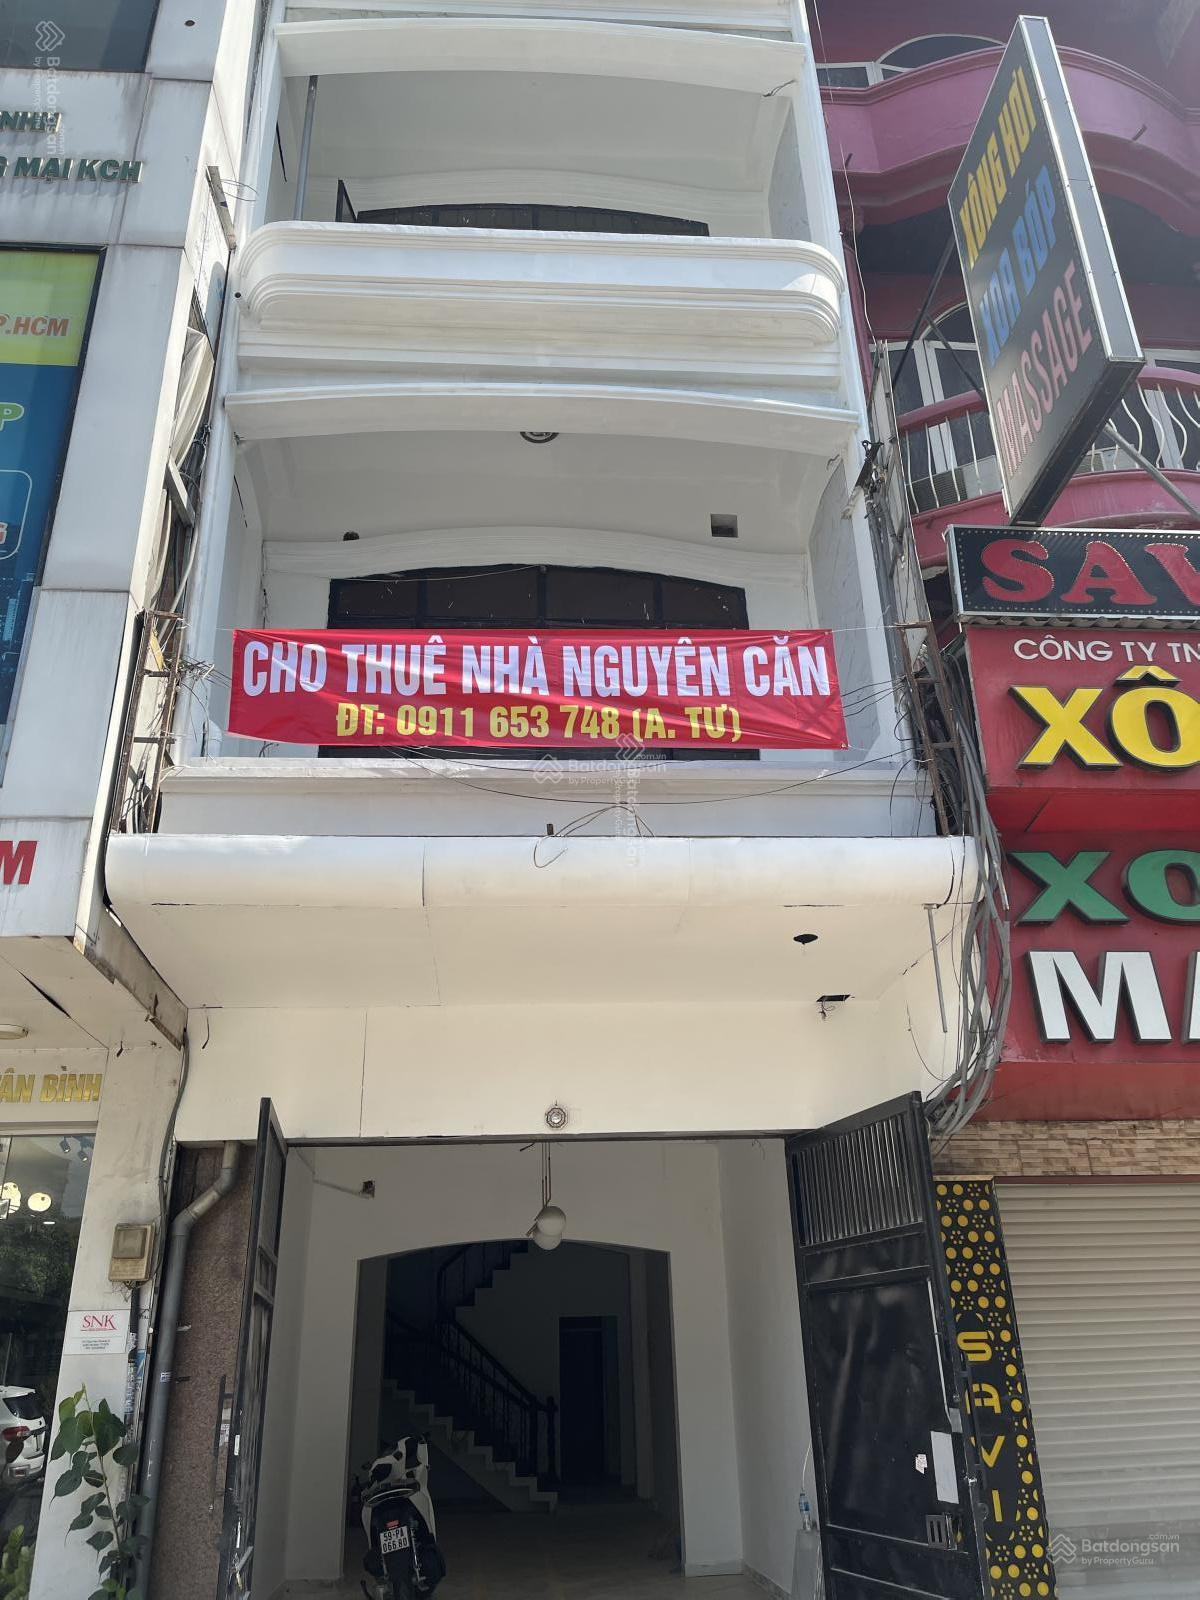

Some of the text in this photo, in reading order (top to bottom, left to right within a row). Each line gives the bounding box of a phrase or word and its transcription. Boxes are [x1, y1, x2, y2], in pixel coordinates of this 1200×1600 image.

[14, 156, 73, 184] MẠI
[77, 159, 143, 184] KCH
[959, 131, 1007, 271] XÔNG
[979, 164, 1056, 368] XOA BÓP
[996, 259, 1093, 478] MASSAGE
[243, 635, 830, 697] CHO THUÊ NHÀ NGUYÊN CĂN
[1013, 634, 1113, 662] CÔNG
[1121, 641, 1156, 662] TY
[336, 703, 742, 743] ĐT: 0911 653 748 (A. TƯ)
[1008, 665, 1200, 774] XÔ
[1007, 850, 1200, 925] XO
[1024, 951, 1200, 1044] M
[82, 1315, 117, 1331] SNK
